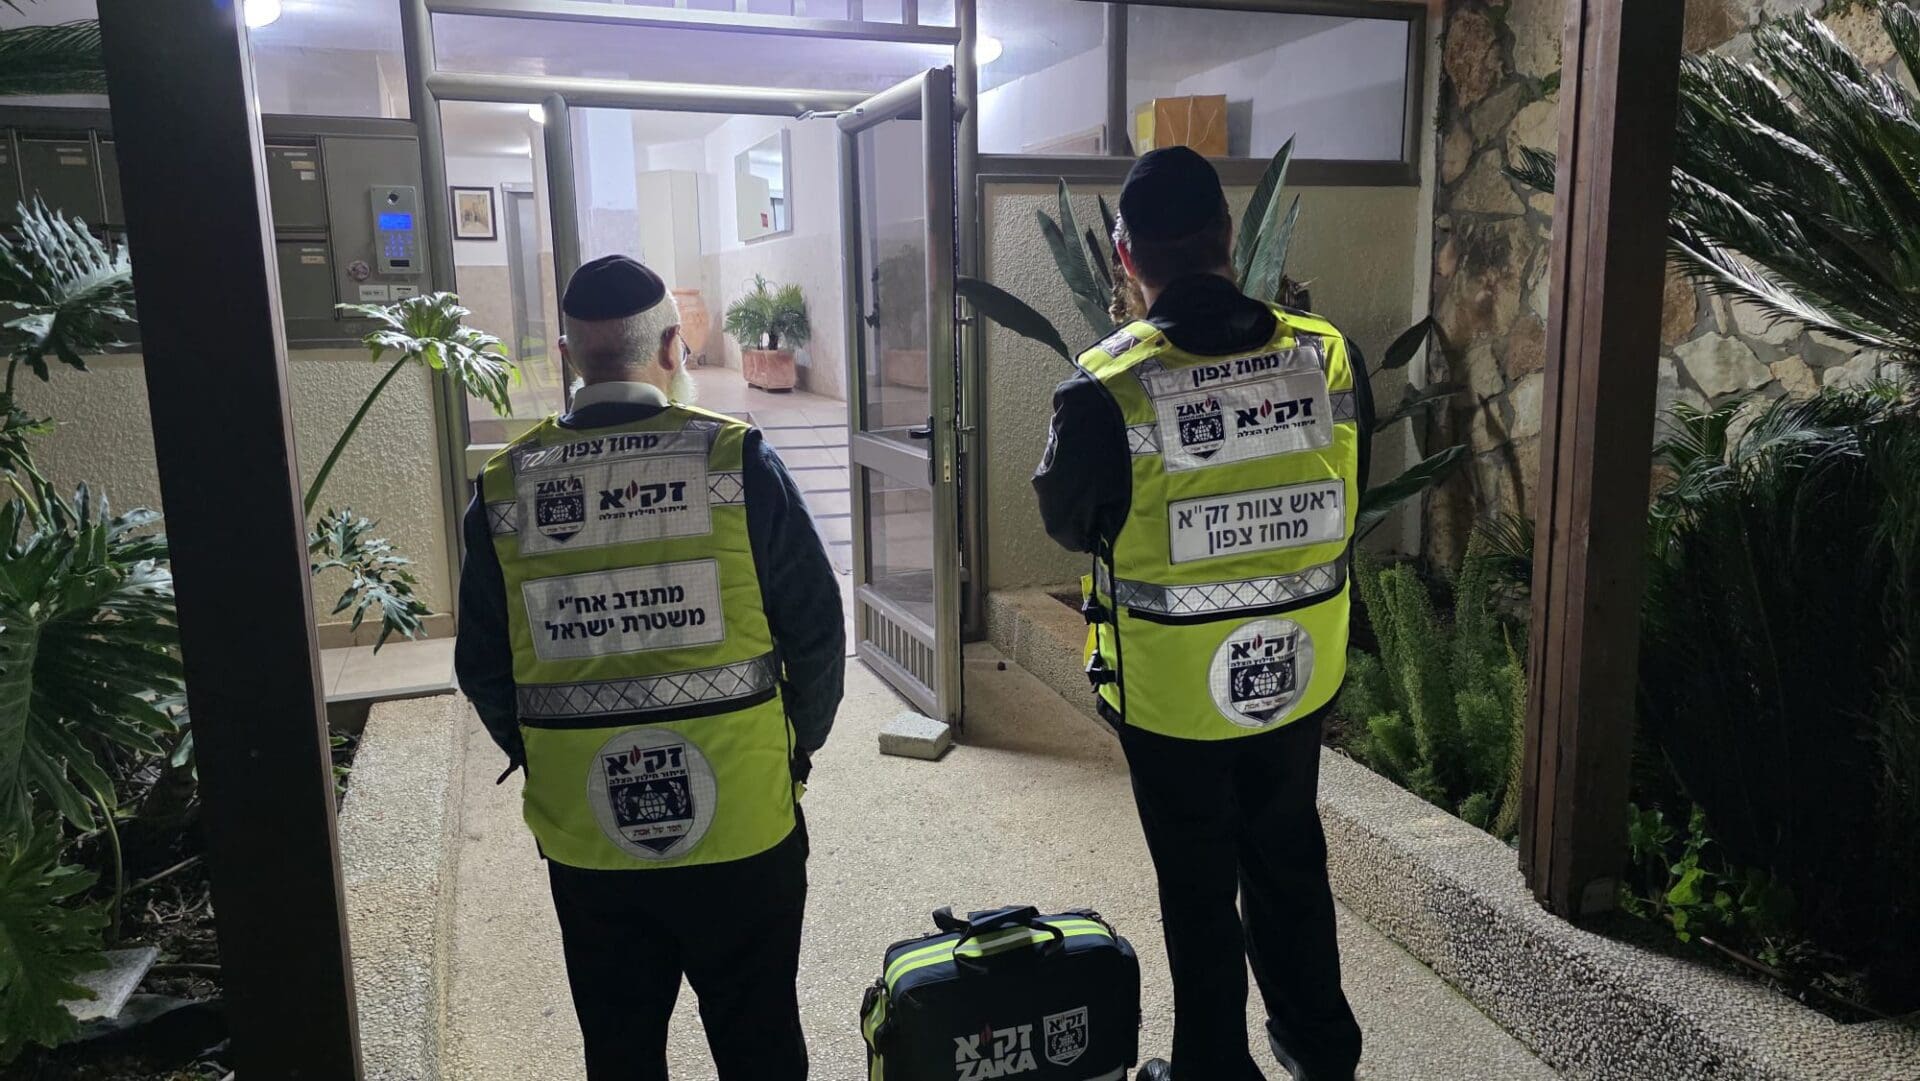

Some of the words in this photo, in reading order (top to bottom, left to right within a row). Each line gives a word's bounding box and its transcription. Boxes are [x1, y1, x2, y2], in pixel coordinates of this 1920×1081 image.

[1192, 363, 1231, 387] צפון
[1236, 353, 1279, 375] מחוז
[608, 435, 659, 452] מחוז
[1237, 428, 1263, 438] הצלה
[562, 439, 605, 463] צפון
[628, 508, 656, 519] חילוץ
[1237, 497, 1283, 521] צוות
[1290, 489, 1338, 514] ראש
[599, 511, 626, 520] הצלה
[1178, 504, 1230, 531] זק"א
[1208, 526, 1253, 555] צפון
[1259, 518, 1308, 543] מחוז
[558, 594, 608, 614] אח"י
[612, 585, 684, 610] מתנדב
[544, 618, 615, 641] ישראל
[621, 607, 706, 633] משטרת
[956, 1049, 1038, 1081] ZAKA
